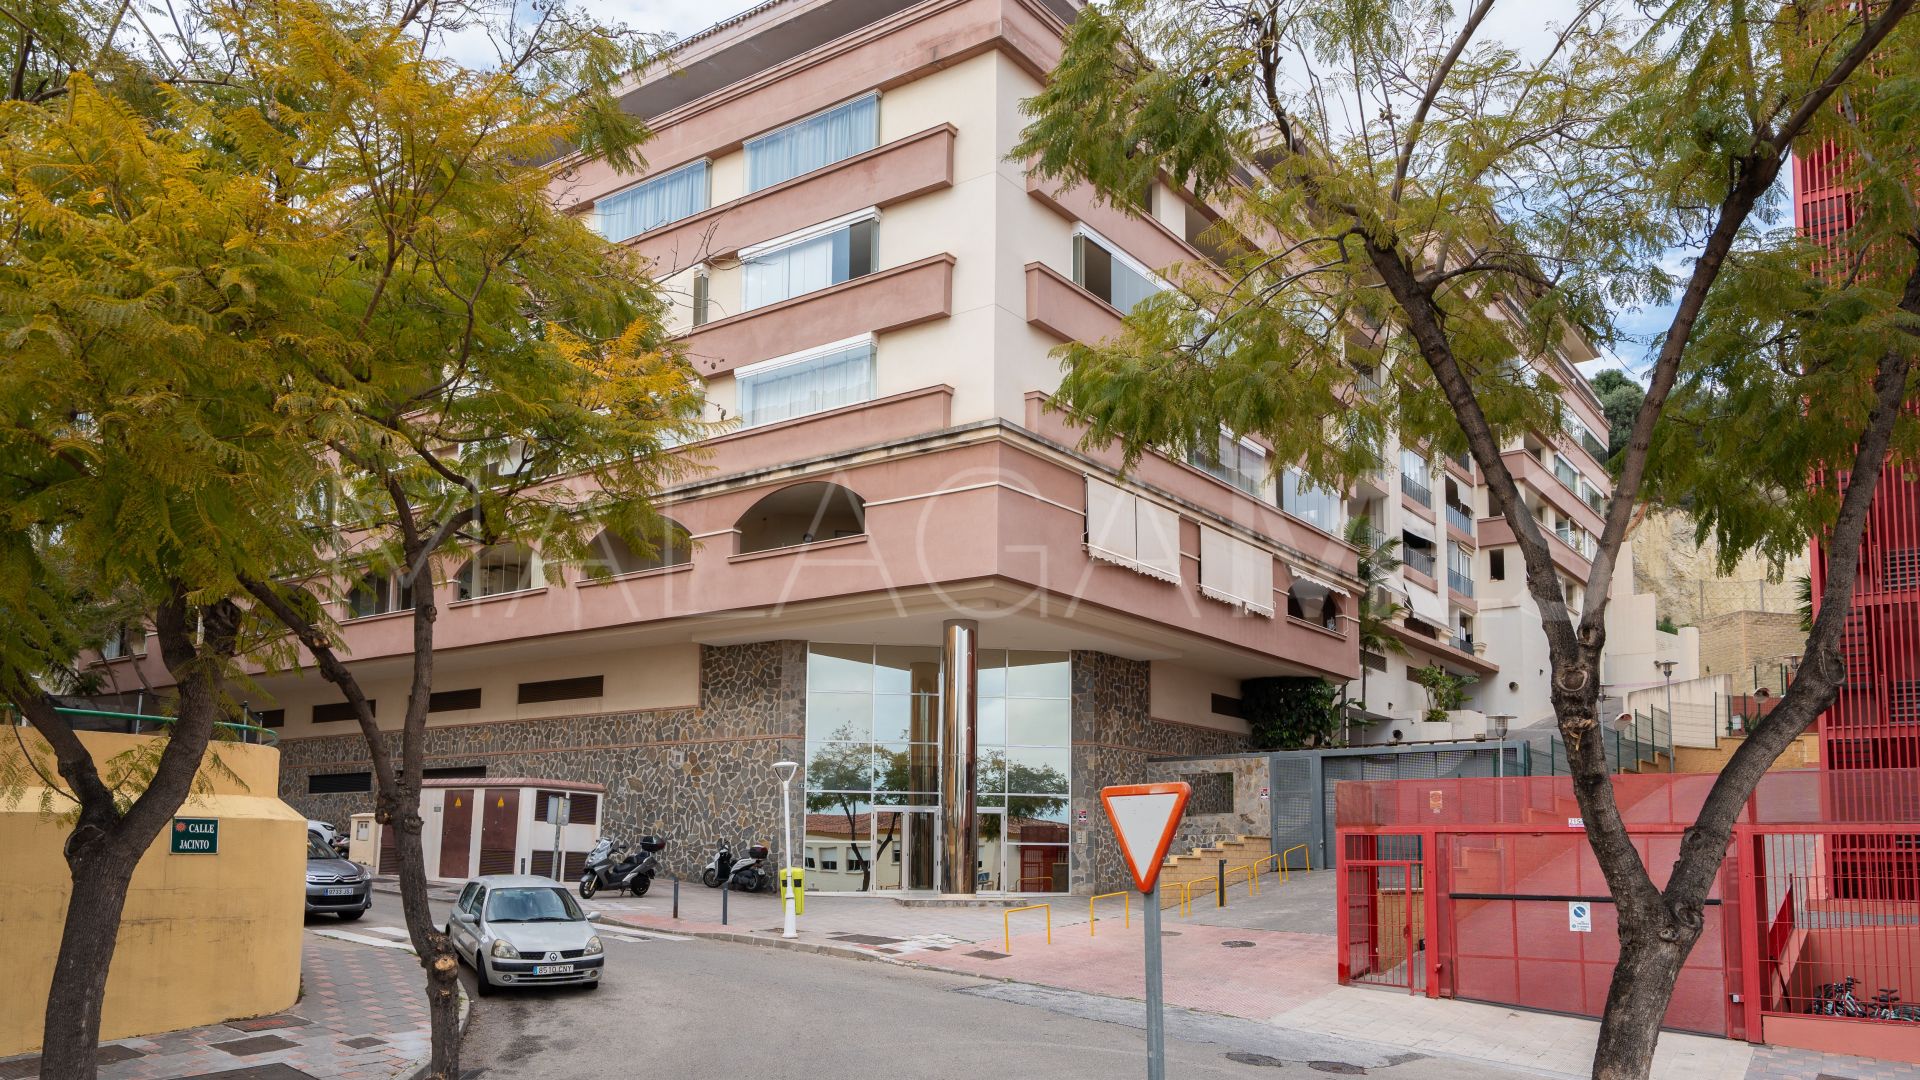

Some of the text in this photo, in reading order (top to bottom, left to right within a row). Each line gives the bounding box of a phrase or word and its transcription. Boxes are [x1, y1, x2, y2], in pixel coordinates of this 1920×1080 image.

[188, 823, 215, 834] CALLE
[179, 839, 210, 850] JACINTO
[558, 965, 572, 973] CNY
